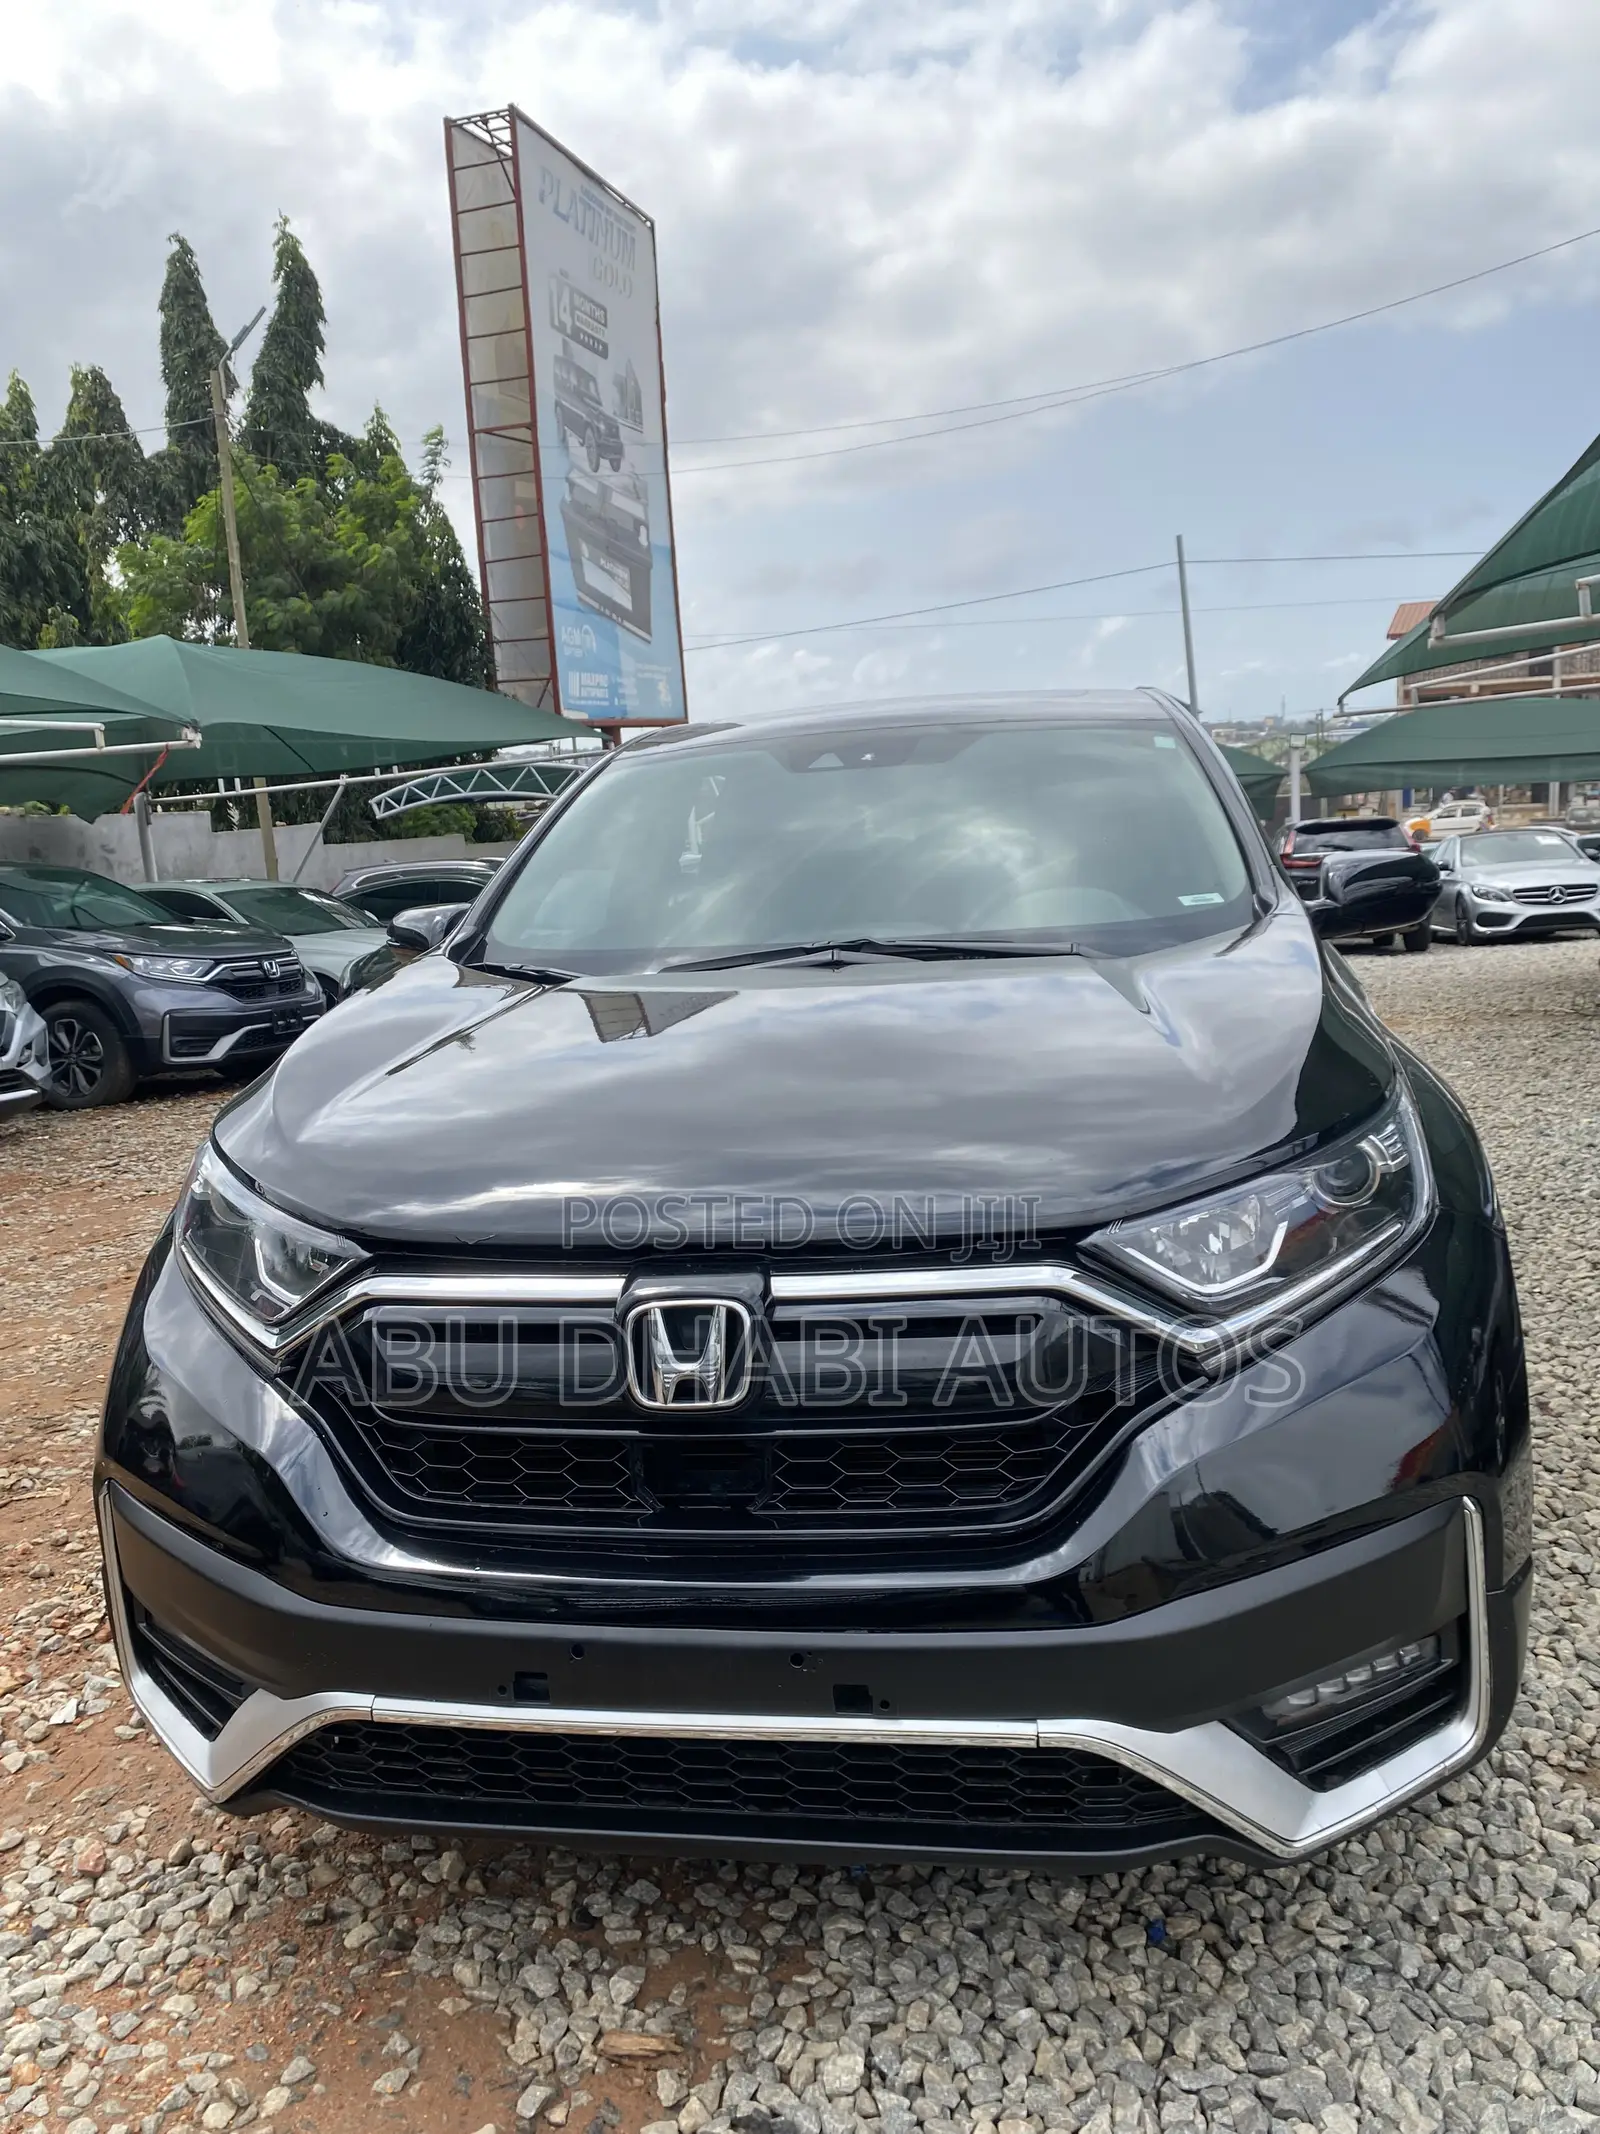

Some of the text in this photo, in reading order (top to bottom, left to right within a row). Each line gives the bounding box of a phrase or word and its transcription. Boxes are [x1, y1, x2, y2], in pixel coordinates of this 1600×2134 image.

[539, 165, 636, 271] PLATINUM
[593, 254, 633, 299] GOLD
[549, 277, 572, 335] 14
[573, 292, 606, 324] MONTHS
[561, 625, 581, 646] AGM
